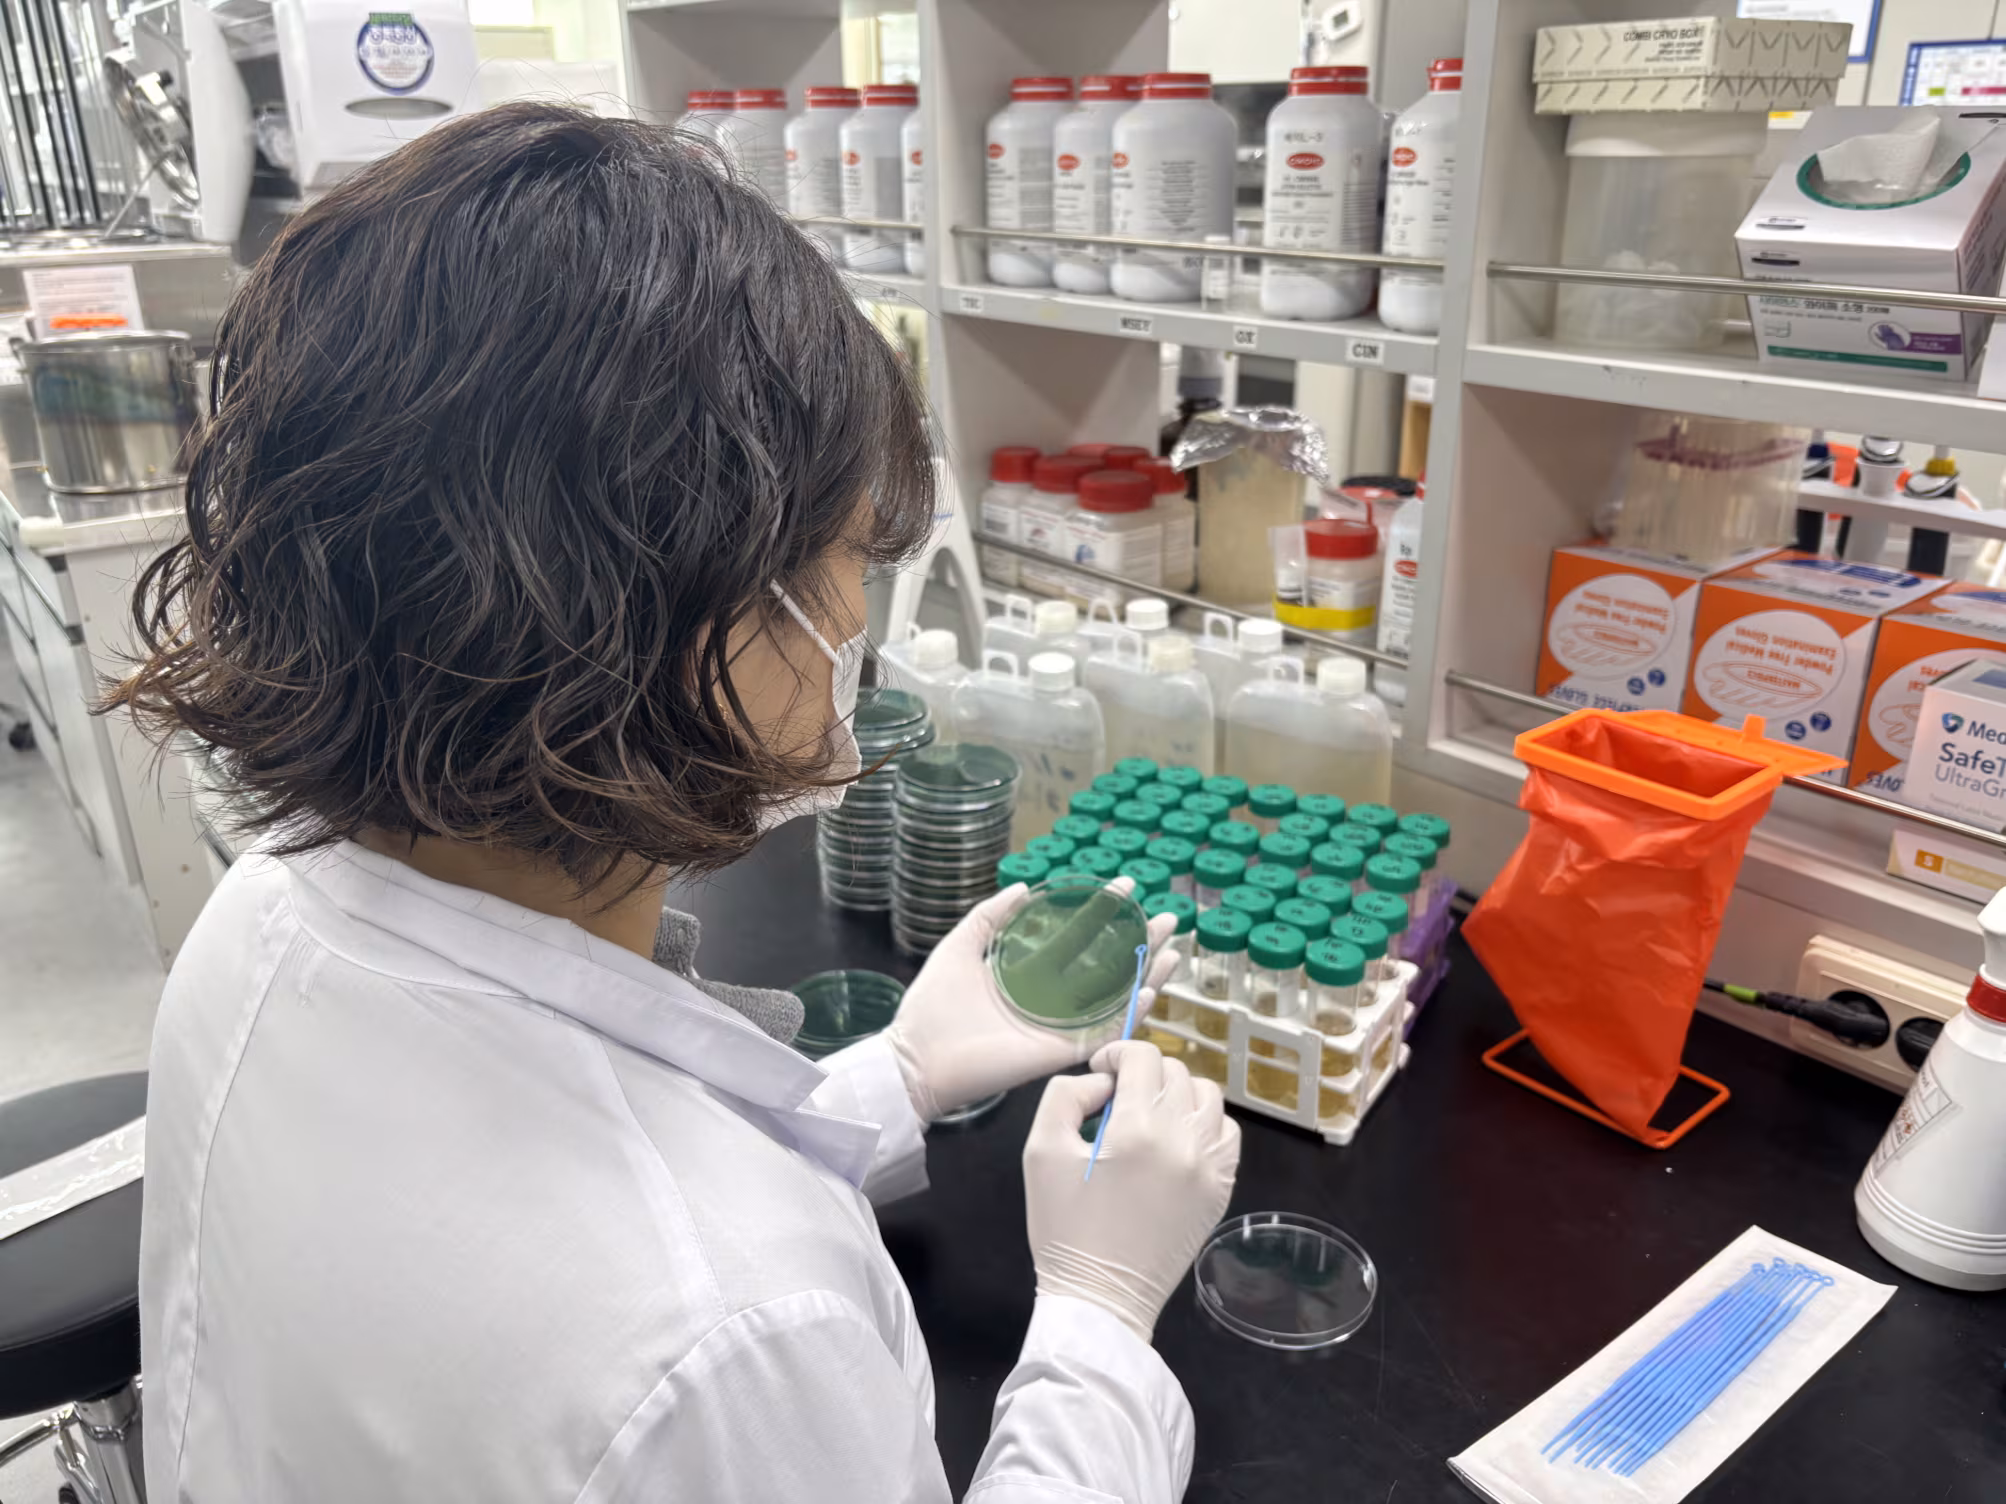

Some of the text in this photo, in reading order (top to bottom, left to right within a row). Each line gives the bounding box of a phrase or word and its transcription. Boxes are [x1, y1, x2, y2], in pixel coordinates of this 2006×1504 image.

[1623, 26, 1704, 42] COMBI CRYO BOX
[1352, 343, 1380, 359] CIN
[1574, 603, 1667, 635] Powder Free Medical
[1582, 589, 1670, 621] Examination Gloves
[1725, 640, 1834, 676] Powder Free Medical
[1735, 626, 1837, 661] Examination Gloves
